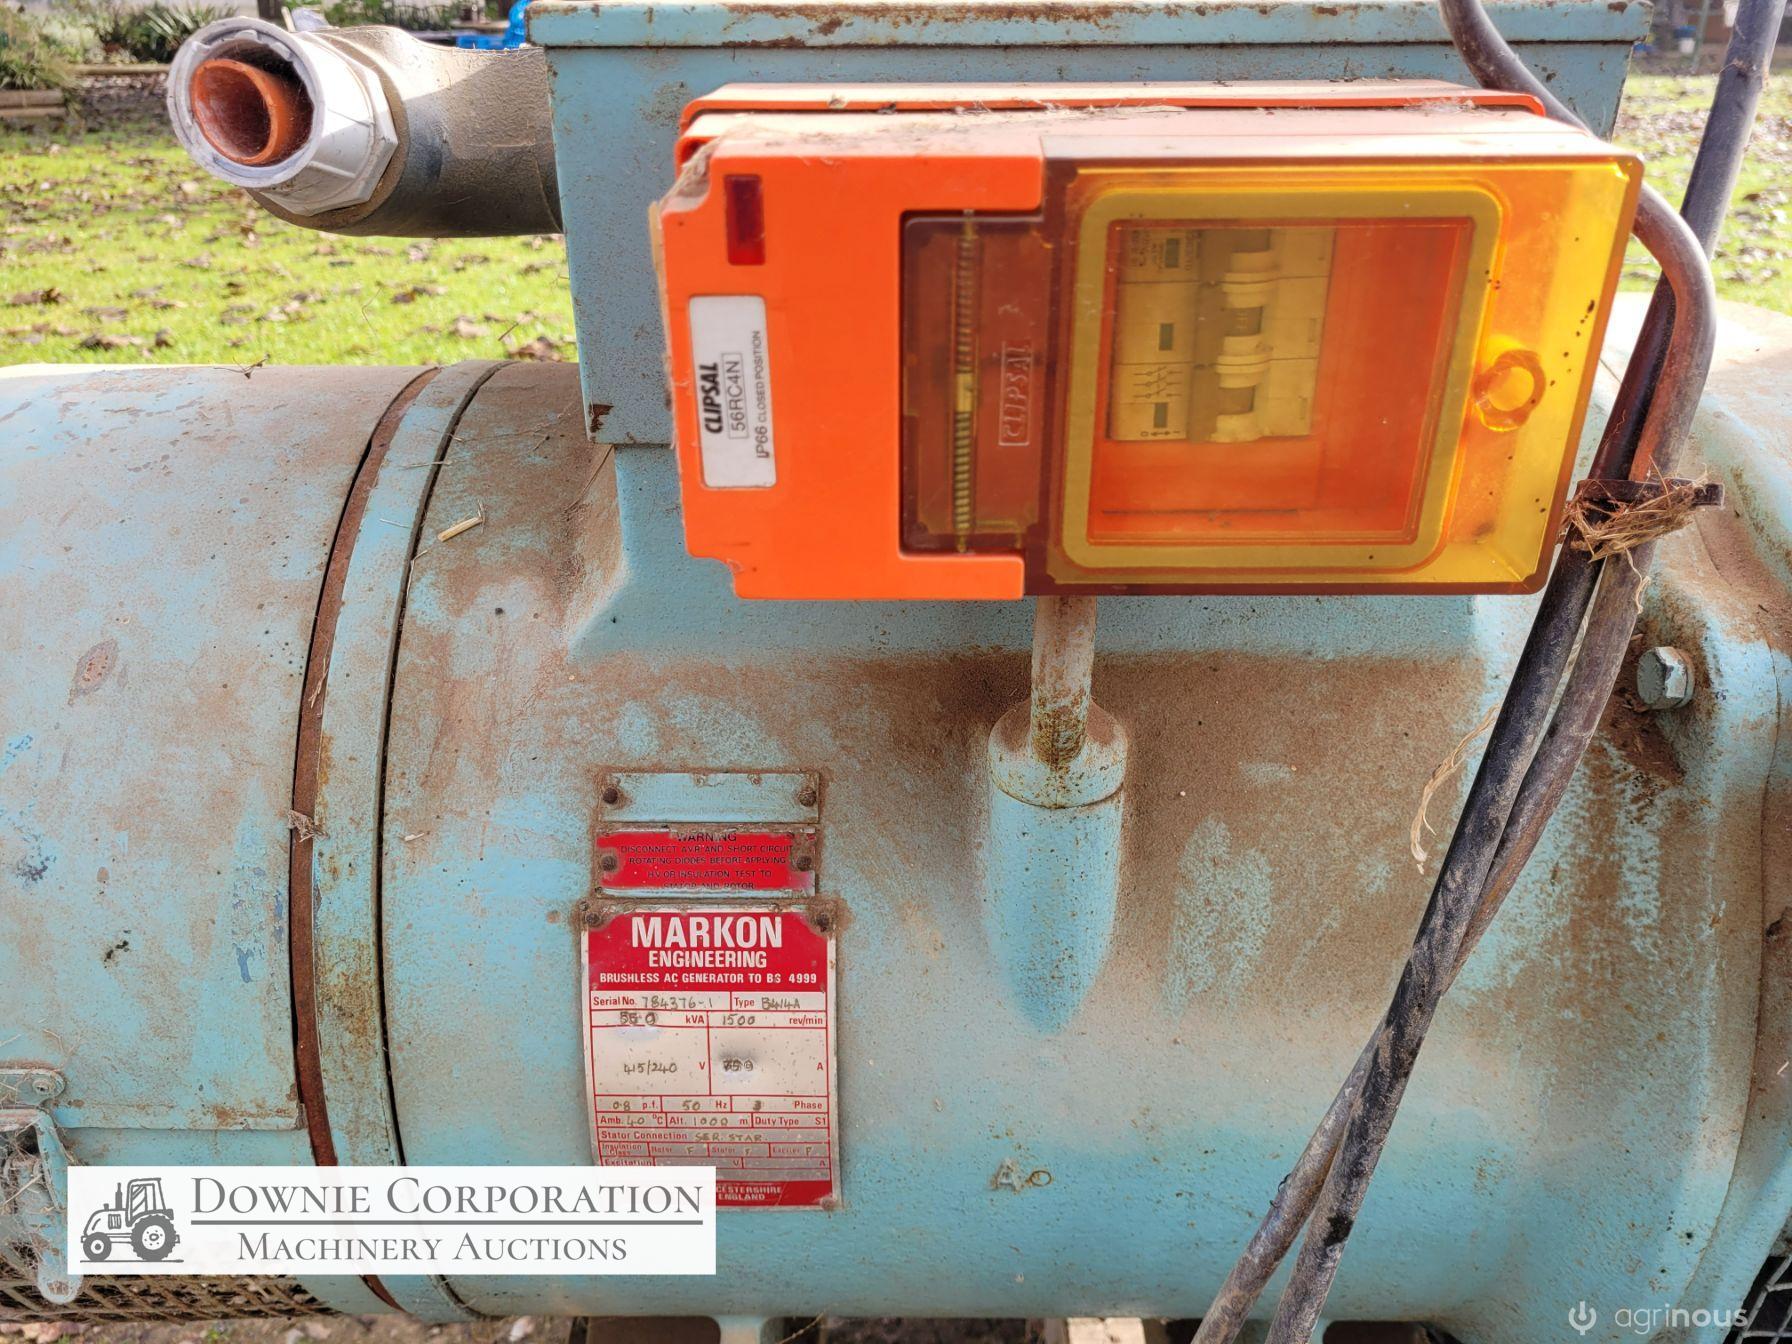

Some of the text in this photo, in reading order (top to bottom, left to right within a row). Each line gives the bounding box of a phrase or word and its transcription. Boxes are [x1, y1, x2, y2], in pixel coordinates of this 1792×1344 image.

[752, 330, 767, 380] POSITION
[1004, 344, 1030, 437] CLIPSAL
[699, 362, 723, 434] CLIPSAL
[725, 360, 746, 432] 56RC4N
[756, 381, 767, 423] CLOSED
[676, 832, 736, 842] WARNING
[620, 845, 676, 853] DISCONNECT
[704, 845, 723, 853] AND
[728, 845, 756, 853] SHORT
[760, 845, 792, 853] CIRCUIT
[675, 857, 706, 865] DIODES
[631, 916, 783, 948] MARKON
[648, 950, 767, 968] ENGINEERING
[599, 972, 817, 983] BRUSHLESS AC GENERATOR TO BS 4999
[593, 997, 621, 1005] Serial
[734, 997, 755, 1008] Type
[685, 1015, 705, 1025] kVA
[722, 1014, 823, 1026] 1500 rev/min
[699, 1062, 706, 1070] V
[817, 1062, 824, 1071] A
[682, 1100, 728, 1111] 50 Hz
[794, 1101, 823, 1110] Phase
[627, 1116, 645, 1127] 40
[693, 1117, 729, 1127] 1000
[755, 1117, 827, 1127] Duty Type S1
[601, 1131, 631, 1140] Stator
[633, 1132, 688, 1140] Connection
[605, 1158, 652, 1166] Excitation
[717, 1186, 782, 1194] CESTERSHIRE
[719, 1193, 766, 1201] ENGLAND
